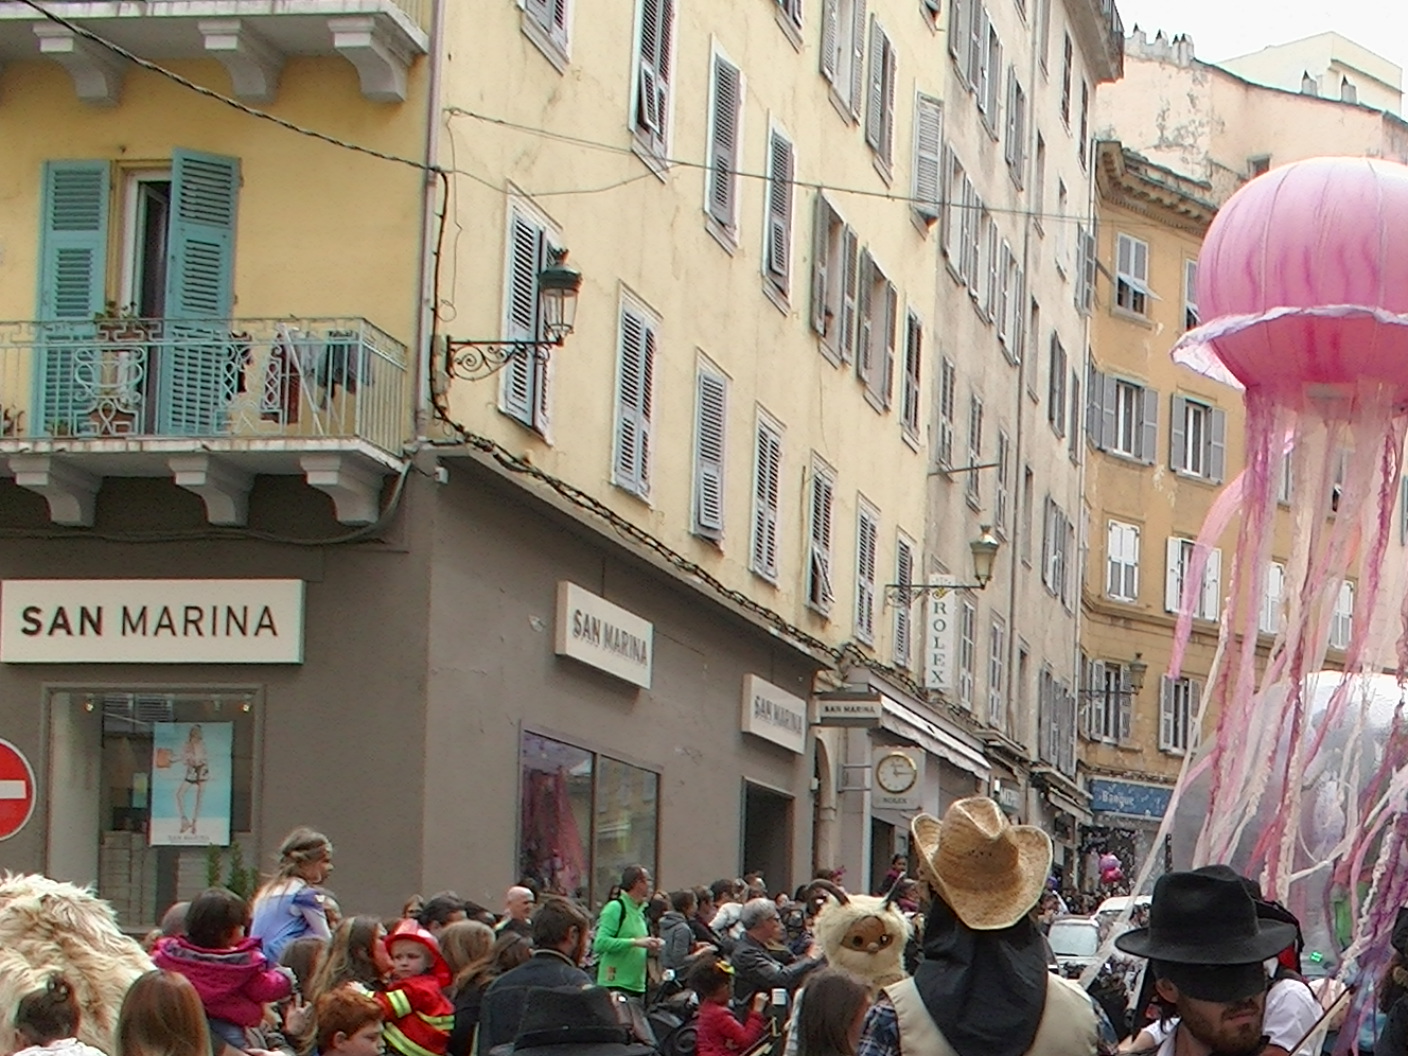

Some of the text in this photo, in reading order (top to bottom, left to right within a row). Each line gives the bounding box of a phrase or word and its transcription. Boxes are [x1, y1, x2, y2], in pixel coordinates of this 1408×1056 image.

[21, 605, 279, 638] SAN MARINA
[573, 609, 648, 668] SAN MARINA
[932, 601, 947, 684] ROLEX
[824, 705, 842, 713] SAN
